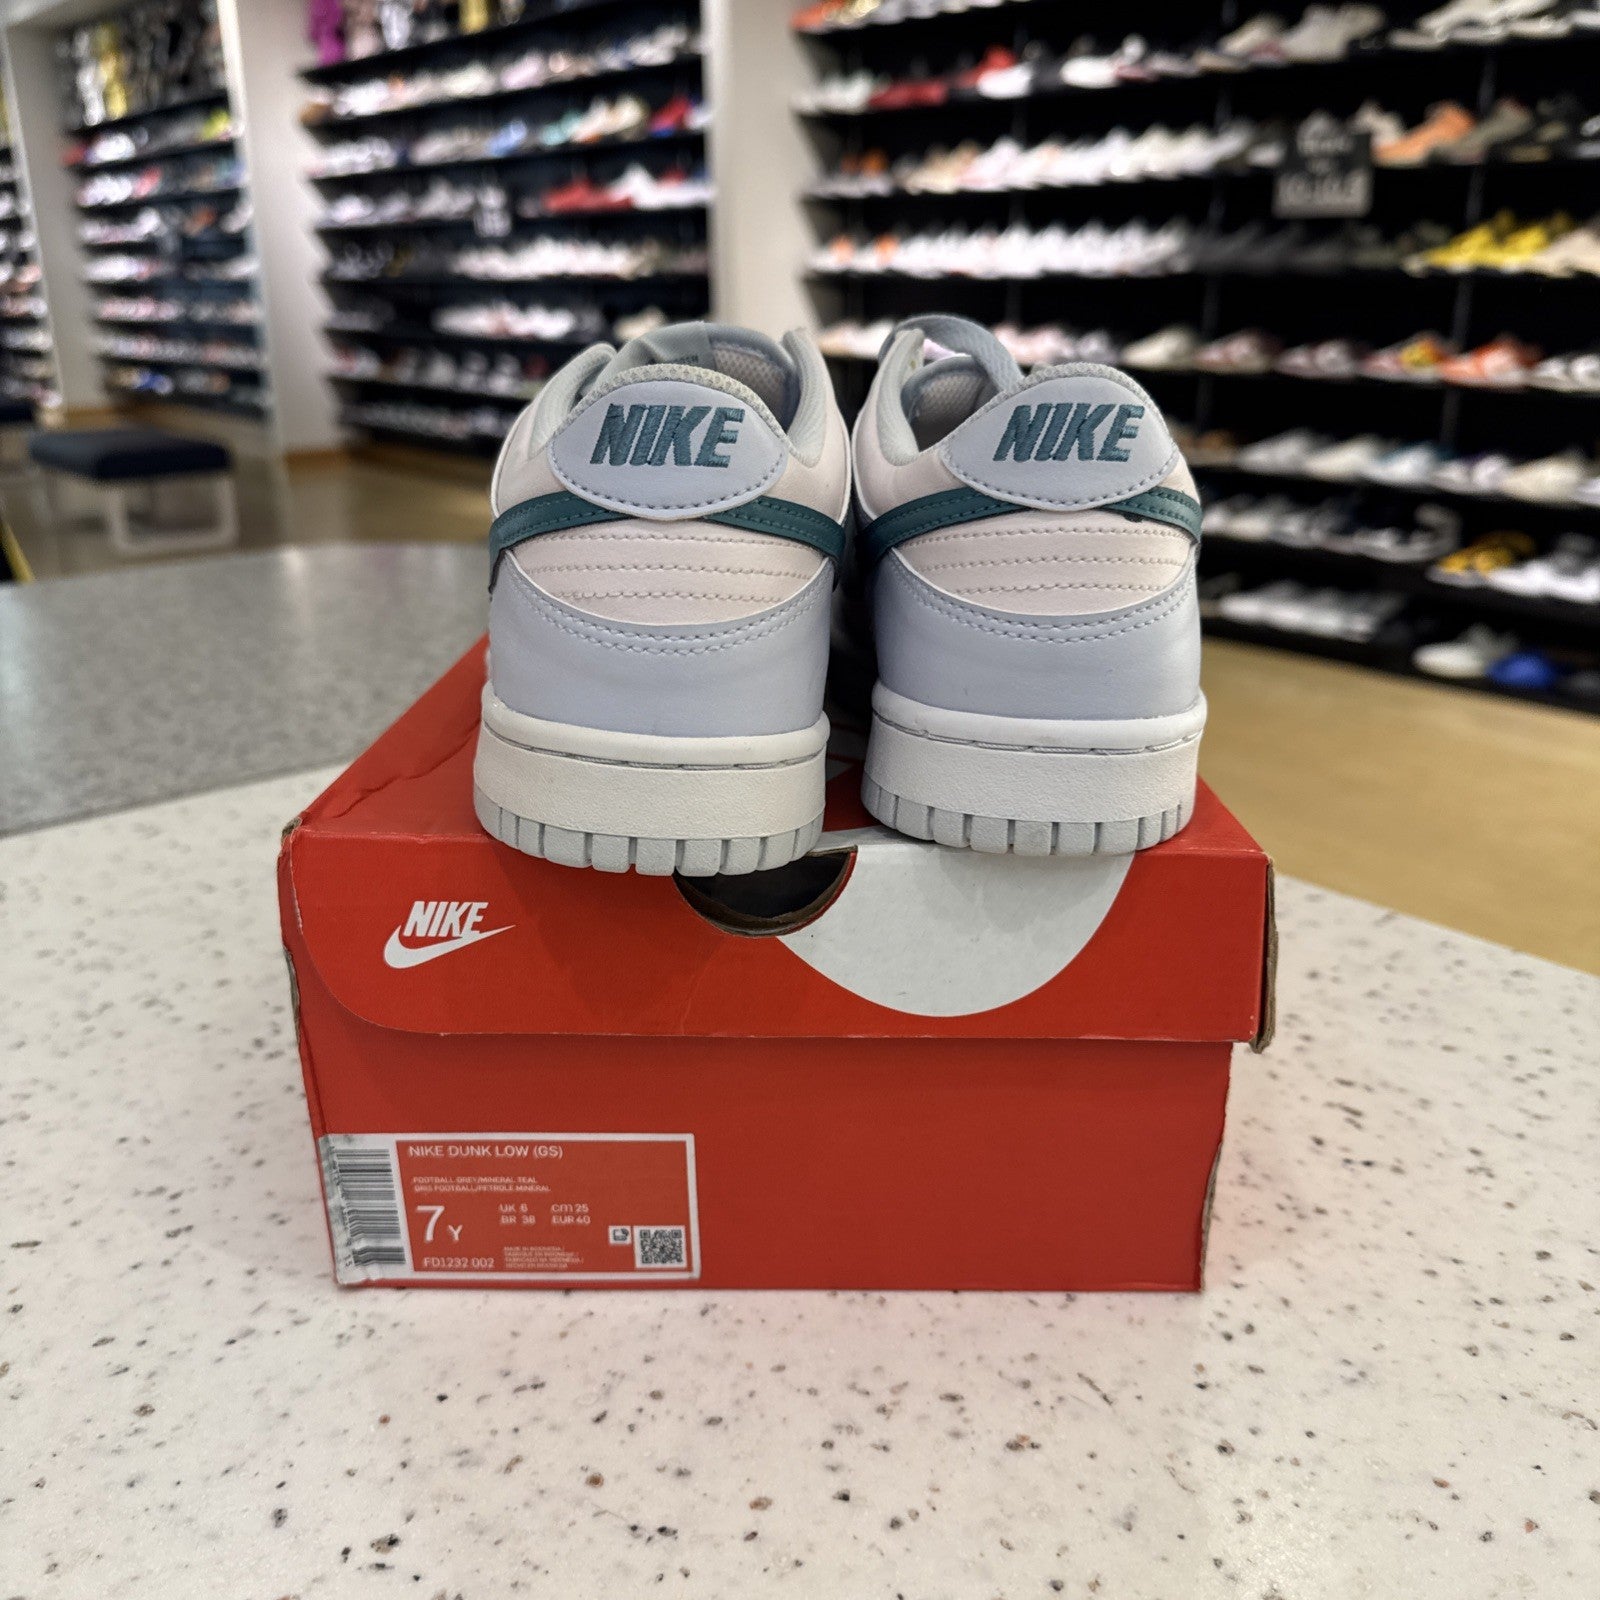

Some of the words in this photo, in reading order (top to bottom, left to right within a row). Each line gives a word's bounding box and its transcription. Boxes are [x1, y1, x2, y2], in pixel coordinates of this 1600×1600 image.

[590, 403, 745, 468] NIKE
[993, 403, 1145, 462] NIKE
[403, 900, 489, 937] NIKE
[409, 1145, 444, 1157] NIKE
[449, 1145, 492, 1157] DUNK
[495, 1145, 529, 1157] LOW
[533, 1145, 563, 1159] (GS)
[518, 1176, 537, 1184] TEAL
[500, 1203, 516, 1213] UK
[520, 1203, 528, 1212] 6
[575, 1203, 589, 1213] 25
[416, 1205, 445, 1242] 7
[448, 1224, 463, 1242] Y
[501, 1215, 517, 1224] BR
[522, 1215, 536, 1225] 38
[552, 1215, 575, 1224] EUR
[576, 1215, 591, 1225] 40
[424, 1257, 469, 1268] FD1232
[472, 1258, 495, 1269] 002
